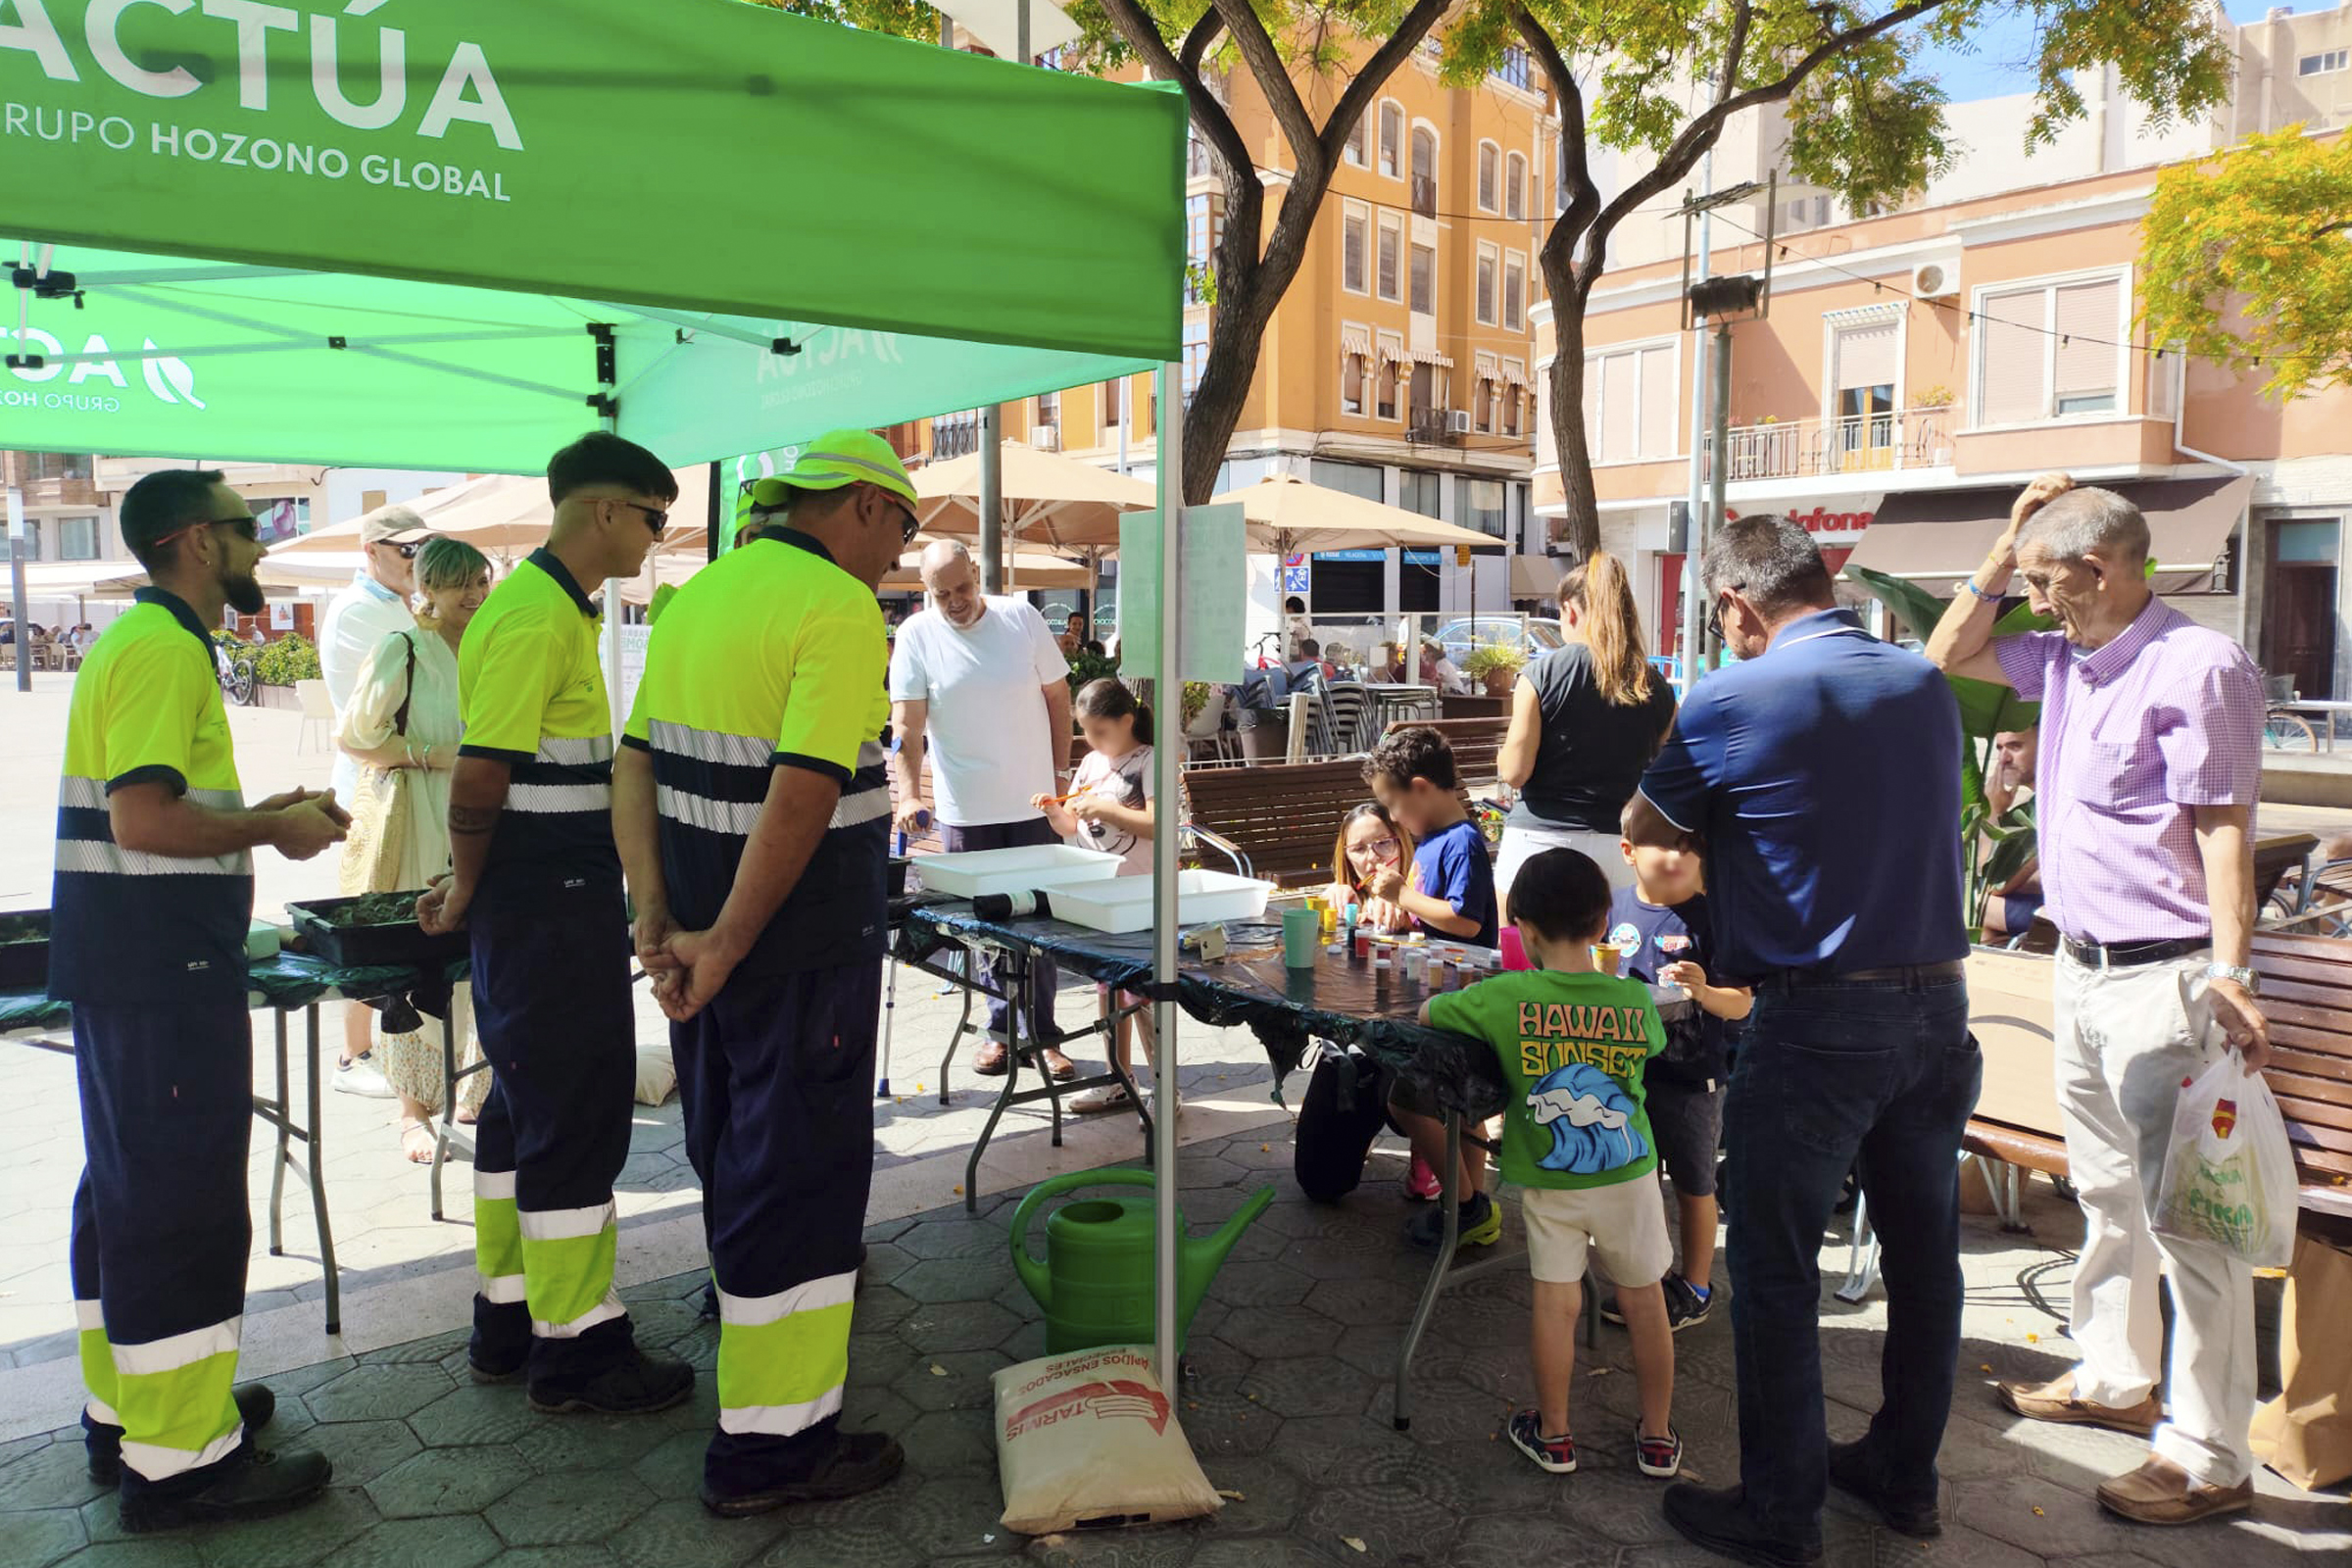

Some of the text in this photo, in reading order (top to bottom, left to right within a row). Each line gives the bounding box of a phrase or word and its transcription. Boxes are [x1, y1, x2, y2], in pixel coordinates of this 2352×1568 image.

[5, 102, 511, 202] RUPO HOZONO GLOBAL
[1519, 1002, 1647, 1042] HAWAII
[1520, 1041, 1647, 1078] SUNSET
[1018, 1359, 1100, 1396] ENSACADOS
